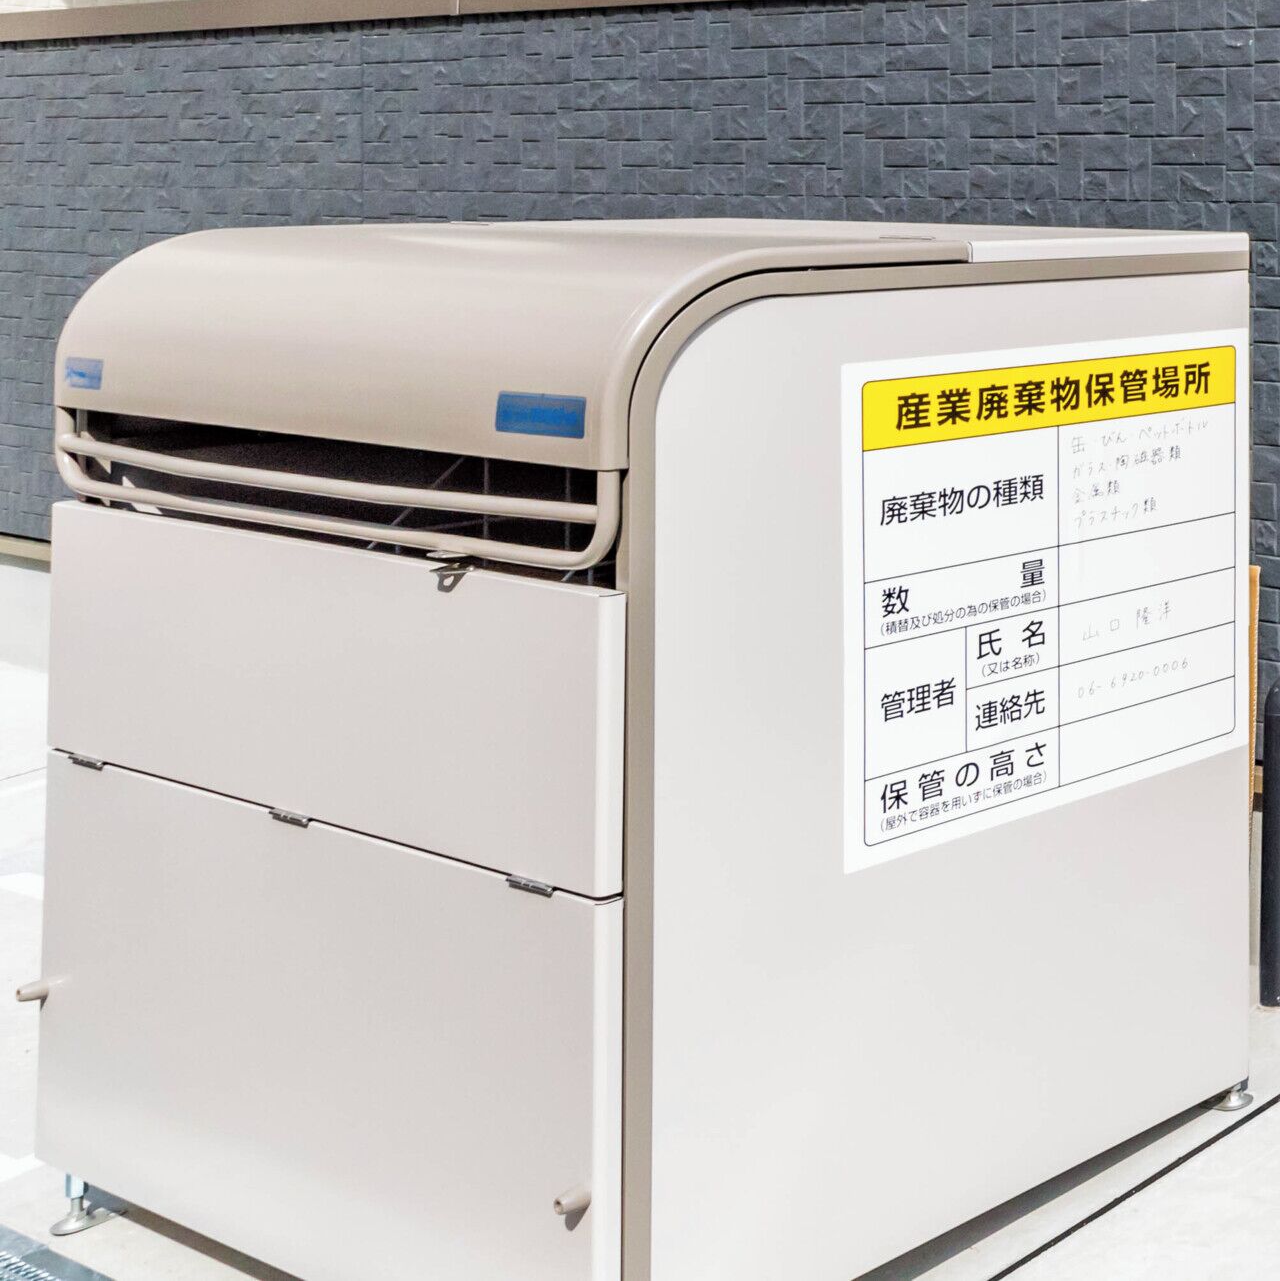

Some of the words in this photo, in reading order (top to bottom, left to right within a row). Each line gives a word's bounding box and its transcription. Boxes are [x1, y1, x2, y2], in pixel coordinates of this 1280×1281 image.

[895, 361, 1211, 432] 産業廃棄物保管場所
[880, 474, 1045, 527] 廃棄物の種類
[981, 652, 1041, 678] （又は名称）
[880, 677, 957, 723] 管理者
[975, 688, 1046, 732] 連絡先
[880, 741, 1047, 815] 保管の高さ
